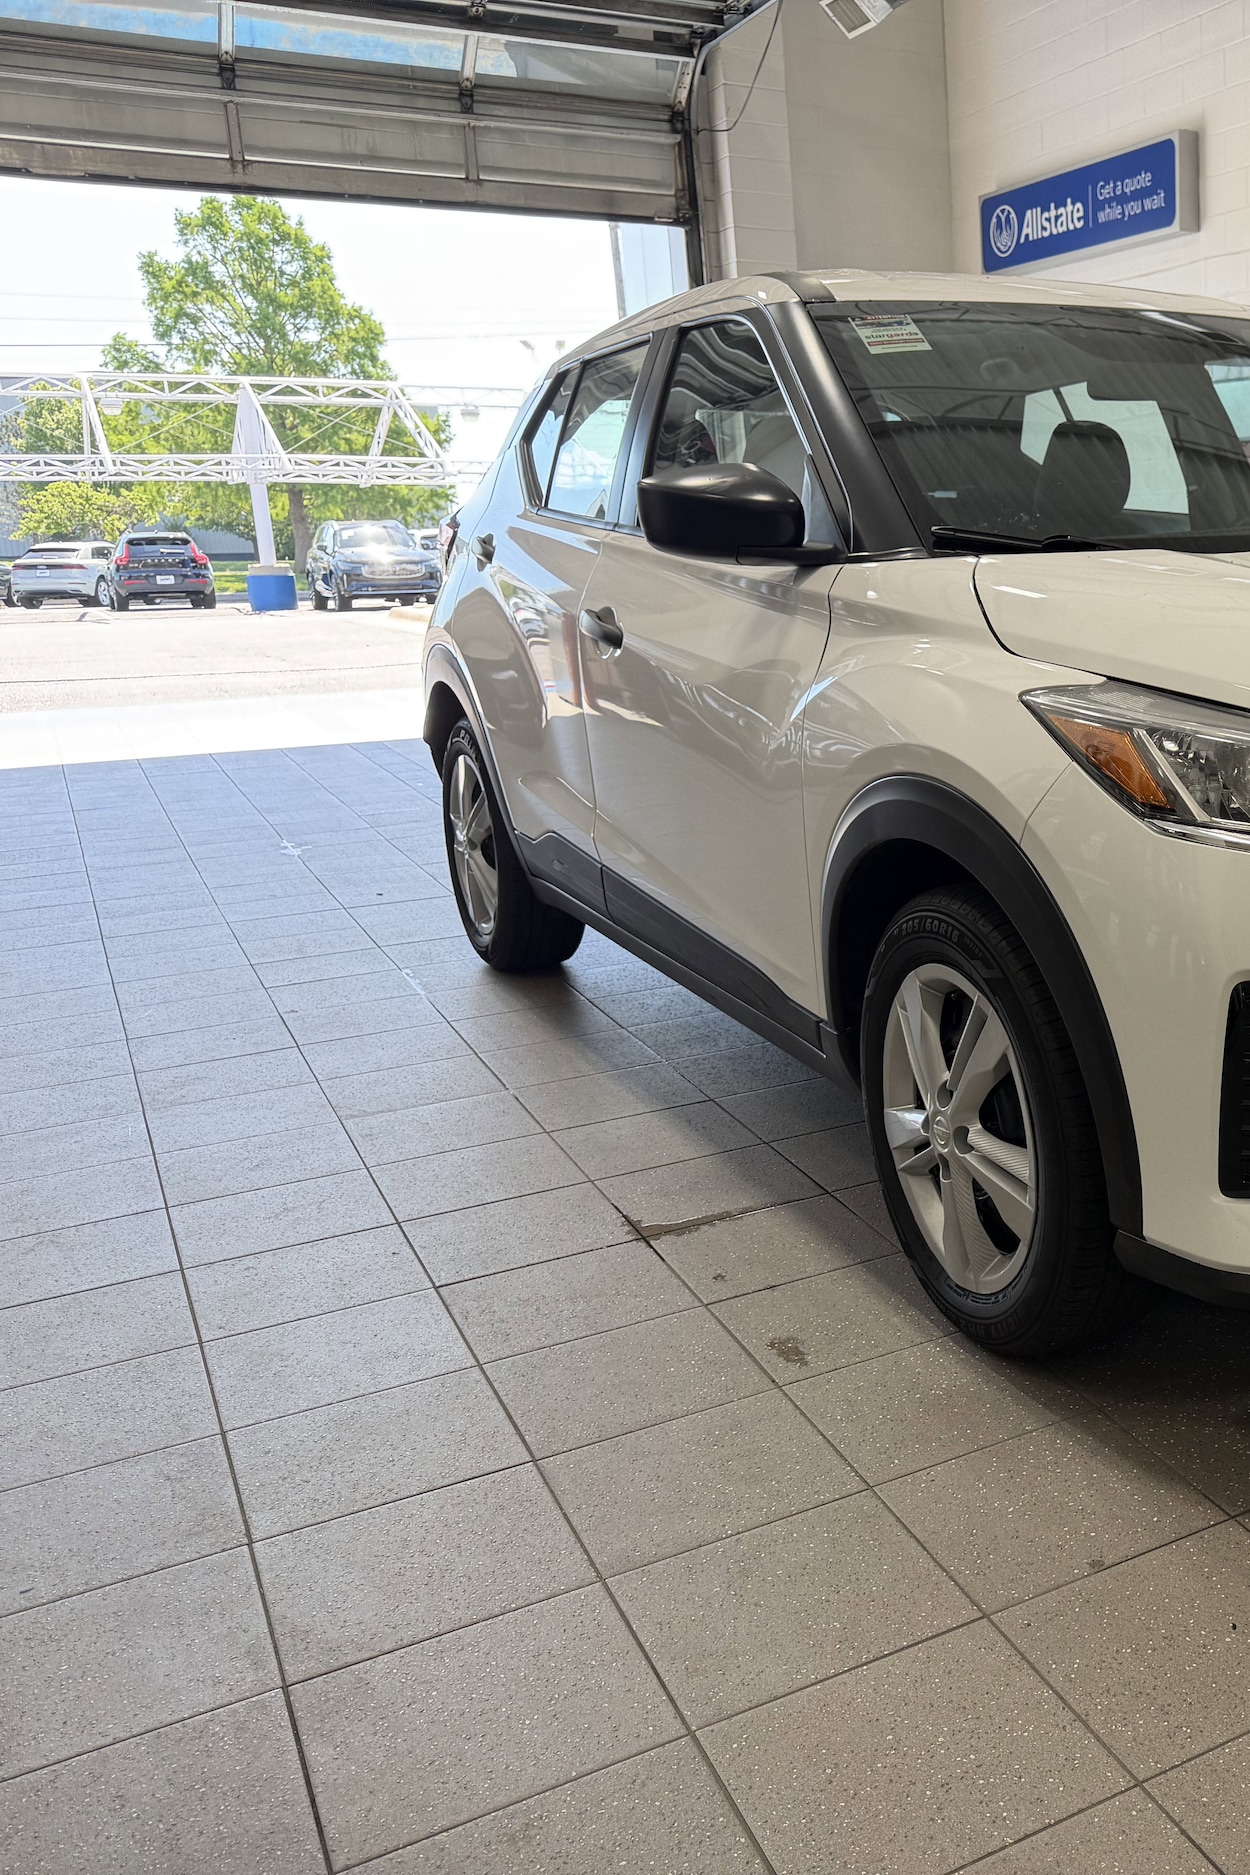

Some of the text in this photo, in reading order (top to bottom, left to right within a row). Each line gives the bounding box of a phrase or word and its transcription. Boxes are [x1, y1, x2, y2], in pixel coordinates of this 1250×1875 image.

[1096, 170, 1152, 200] Get a quote
[1019, 197, 1084, 244] Allstate
[1097, 189, 1166, 224] while you wait
[901, 918, 960, 943] 205/60R16
